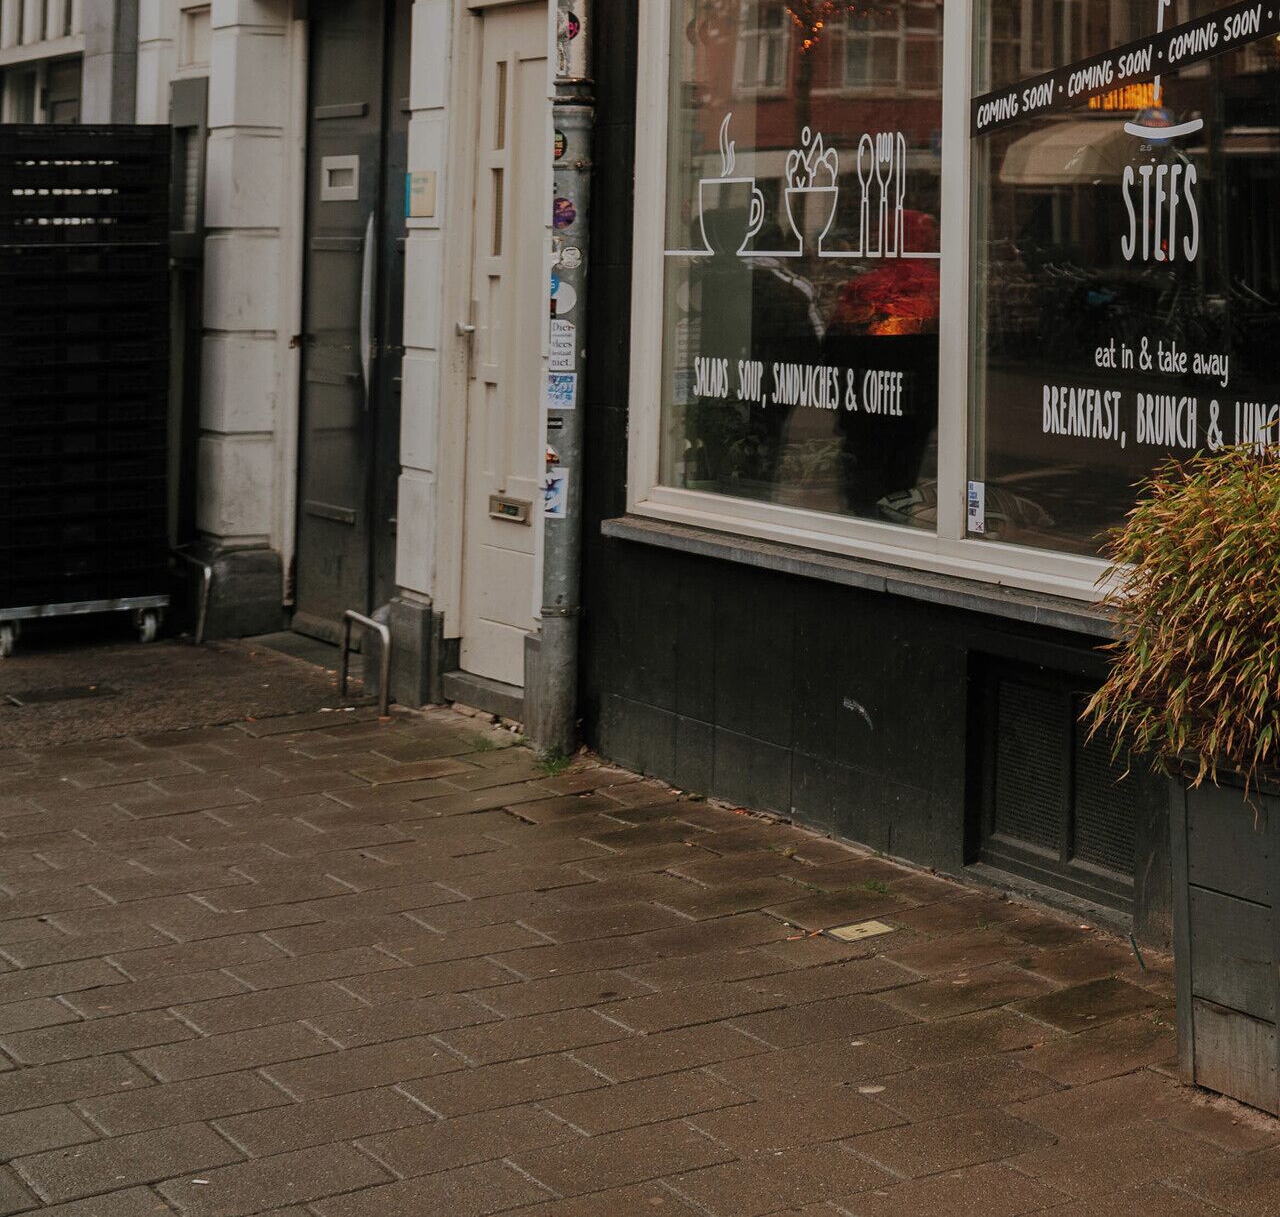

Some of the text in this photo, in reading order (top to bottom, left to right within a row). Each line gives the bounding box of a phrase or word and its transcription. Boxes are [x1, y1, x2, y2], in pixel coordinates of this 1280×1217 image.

[976, 94, 1019, 129] COMING
[1022, 79, 1054, 111] SOON
[1067, 60, 1113, 98] COMING
[1117, 45, 1153, 79] SOON
[1168, 23, 1218, 64] COMING
[1224, 4, 1261, 41] SOON
[1121, 163, 1199, 262] STEFS
[693, 355, 904, 417] SALADS SOUP, SANDWICHES & COFFEE
[1094, 336, 1229, 388] eat in & take away
[1042, 384, 1126, 449] BREAKFAST,
[1136, 392, 1198, 450] BRUNCH
[1206, 399, 1224, 452] &
